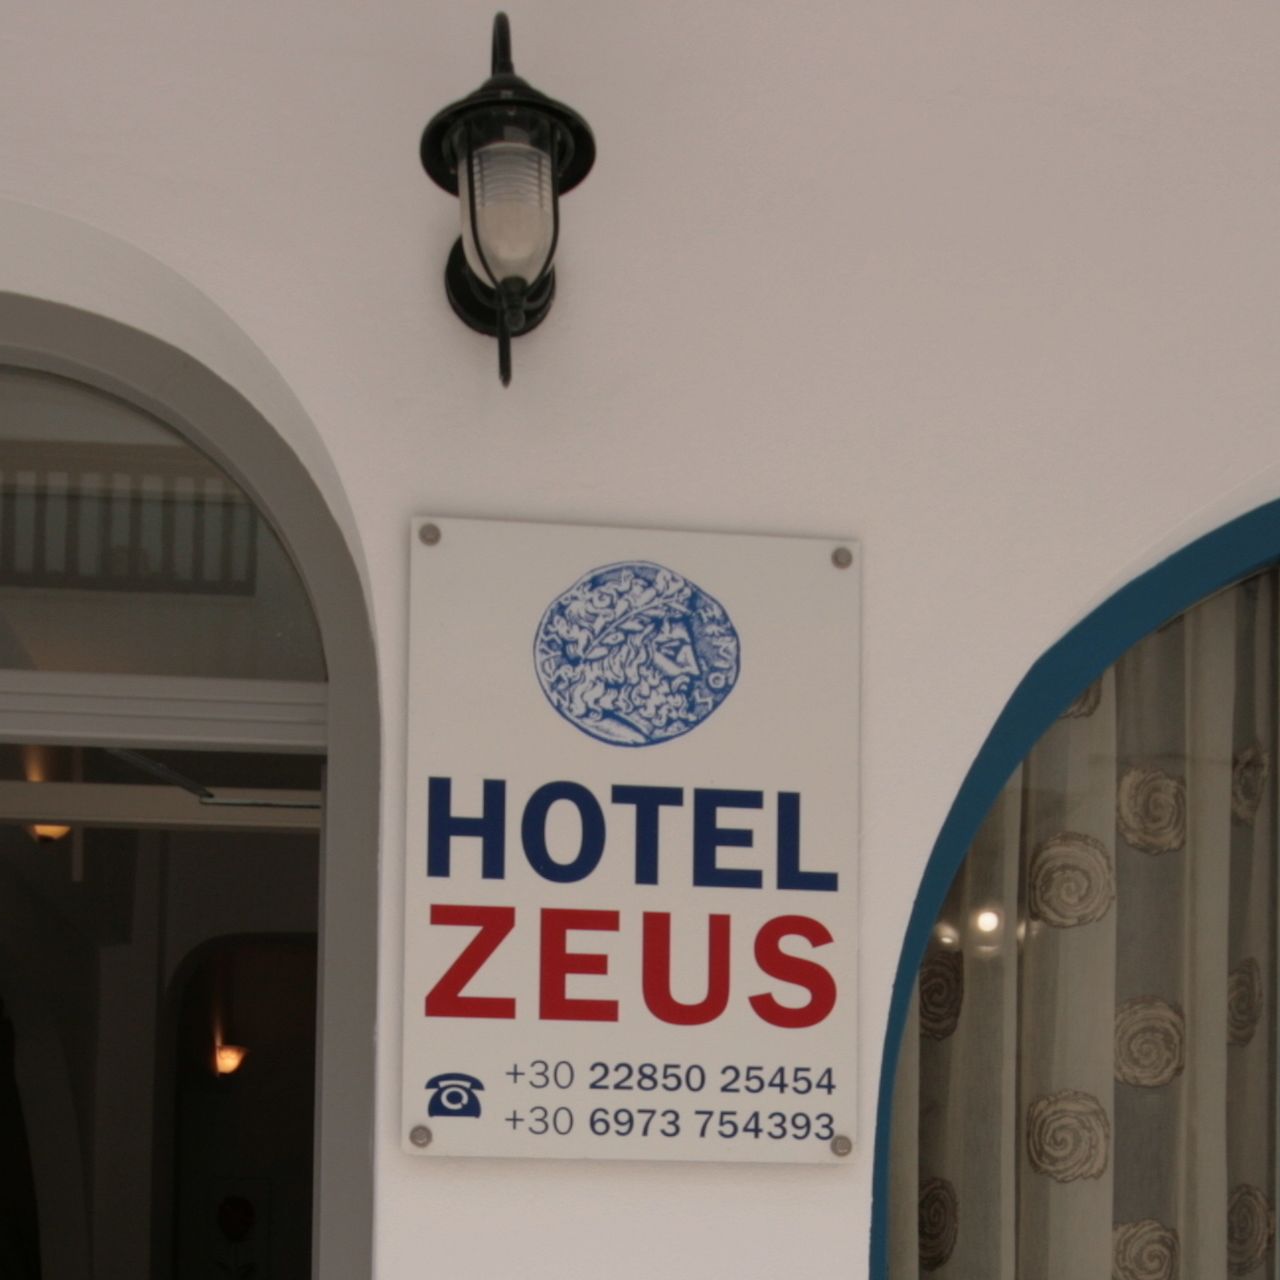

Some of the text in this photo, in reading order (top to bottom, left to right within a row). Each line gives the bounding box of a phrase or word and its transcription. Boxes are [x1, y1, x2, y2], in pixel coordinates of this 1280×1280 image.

[426, 776, 839, 893] HOTEL
[424, 903, 838, 1029] ZEUS
[505, 1060, 837, 1096] +30 22850 25454
[504, 1106, 836, 1142] +30 6973 754393
